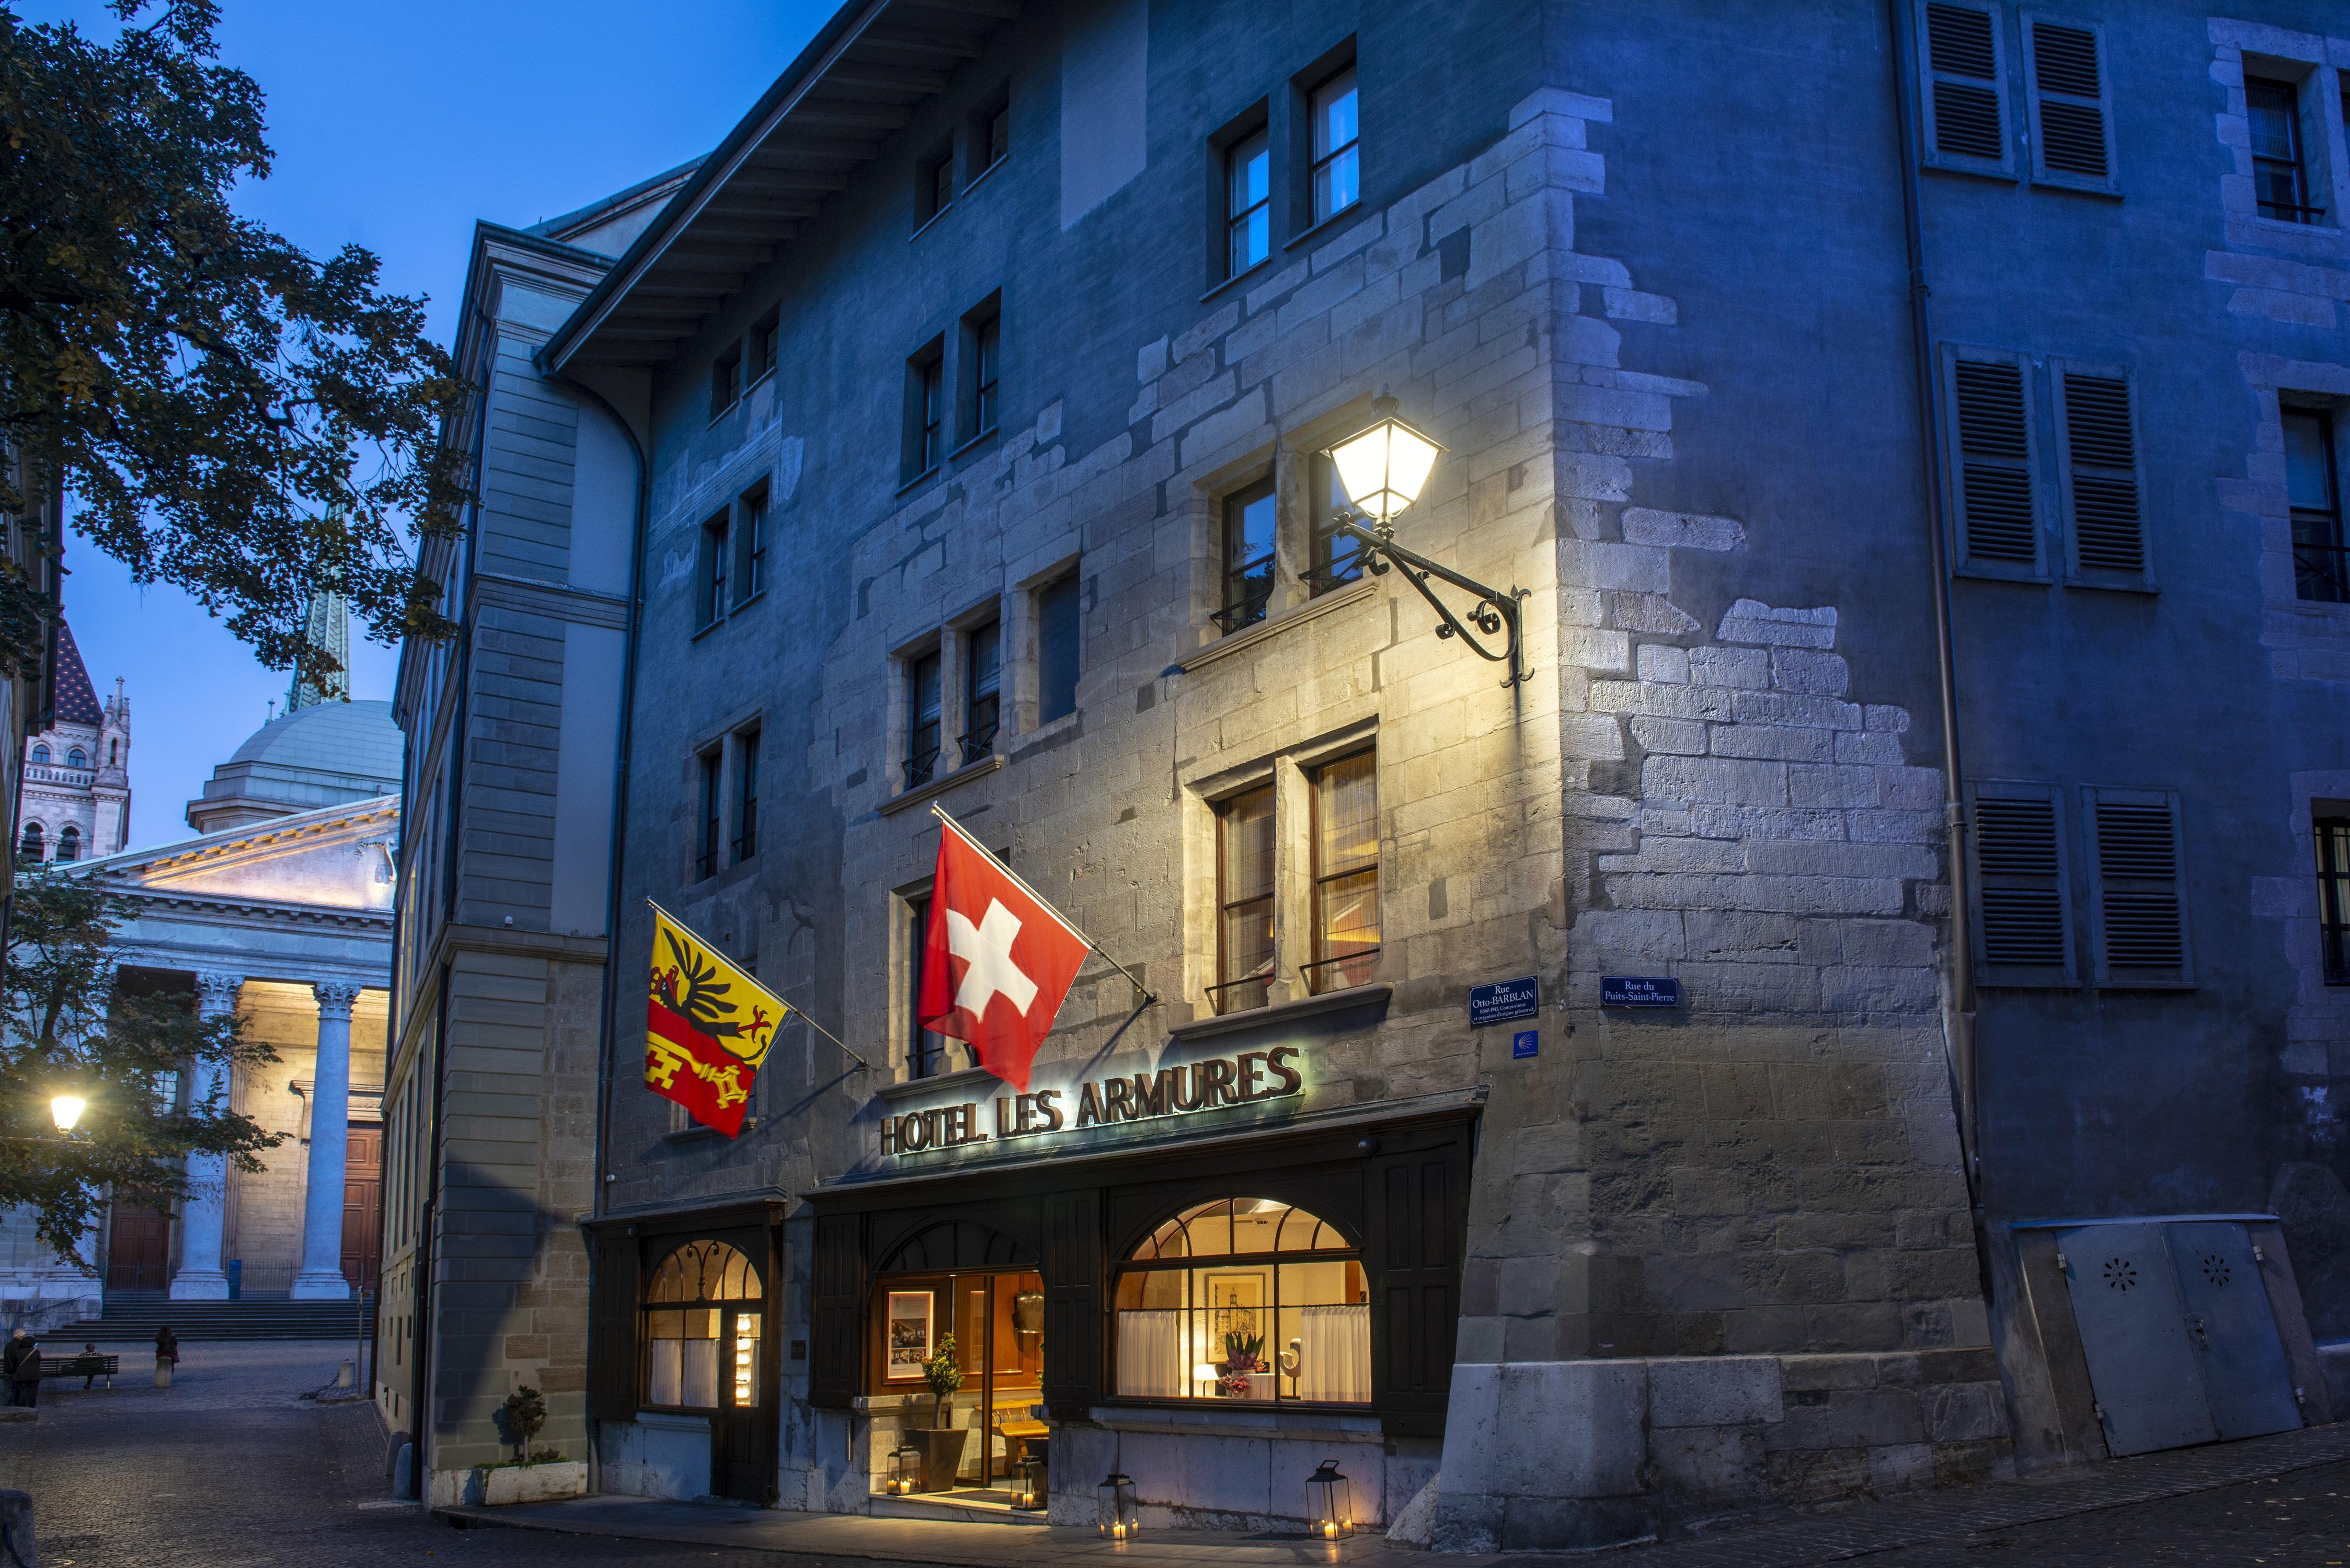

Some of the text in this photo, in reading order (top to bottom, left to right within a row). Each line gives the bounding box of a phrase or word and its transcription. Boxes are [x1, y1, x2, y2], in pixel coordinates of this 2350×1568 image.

[1495, 985, 1510, 994] Rue
[1625, 981, 1654, 990] Rue du
[1473, 989, 1533, 1008] Otto-BARBLAN
[1605, 991, 1675, 1001] Puits-Saint-Pierre
[1500, 1002, 1526, 1011] Compositeur
[1515, 1006, 1533, 1015] grisonne)
[880, 1046, 1302, 1156] HOTEL LES ARMURES
